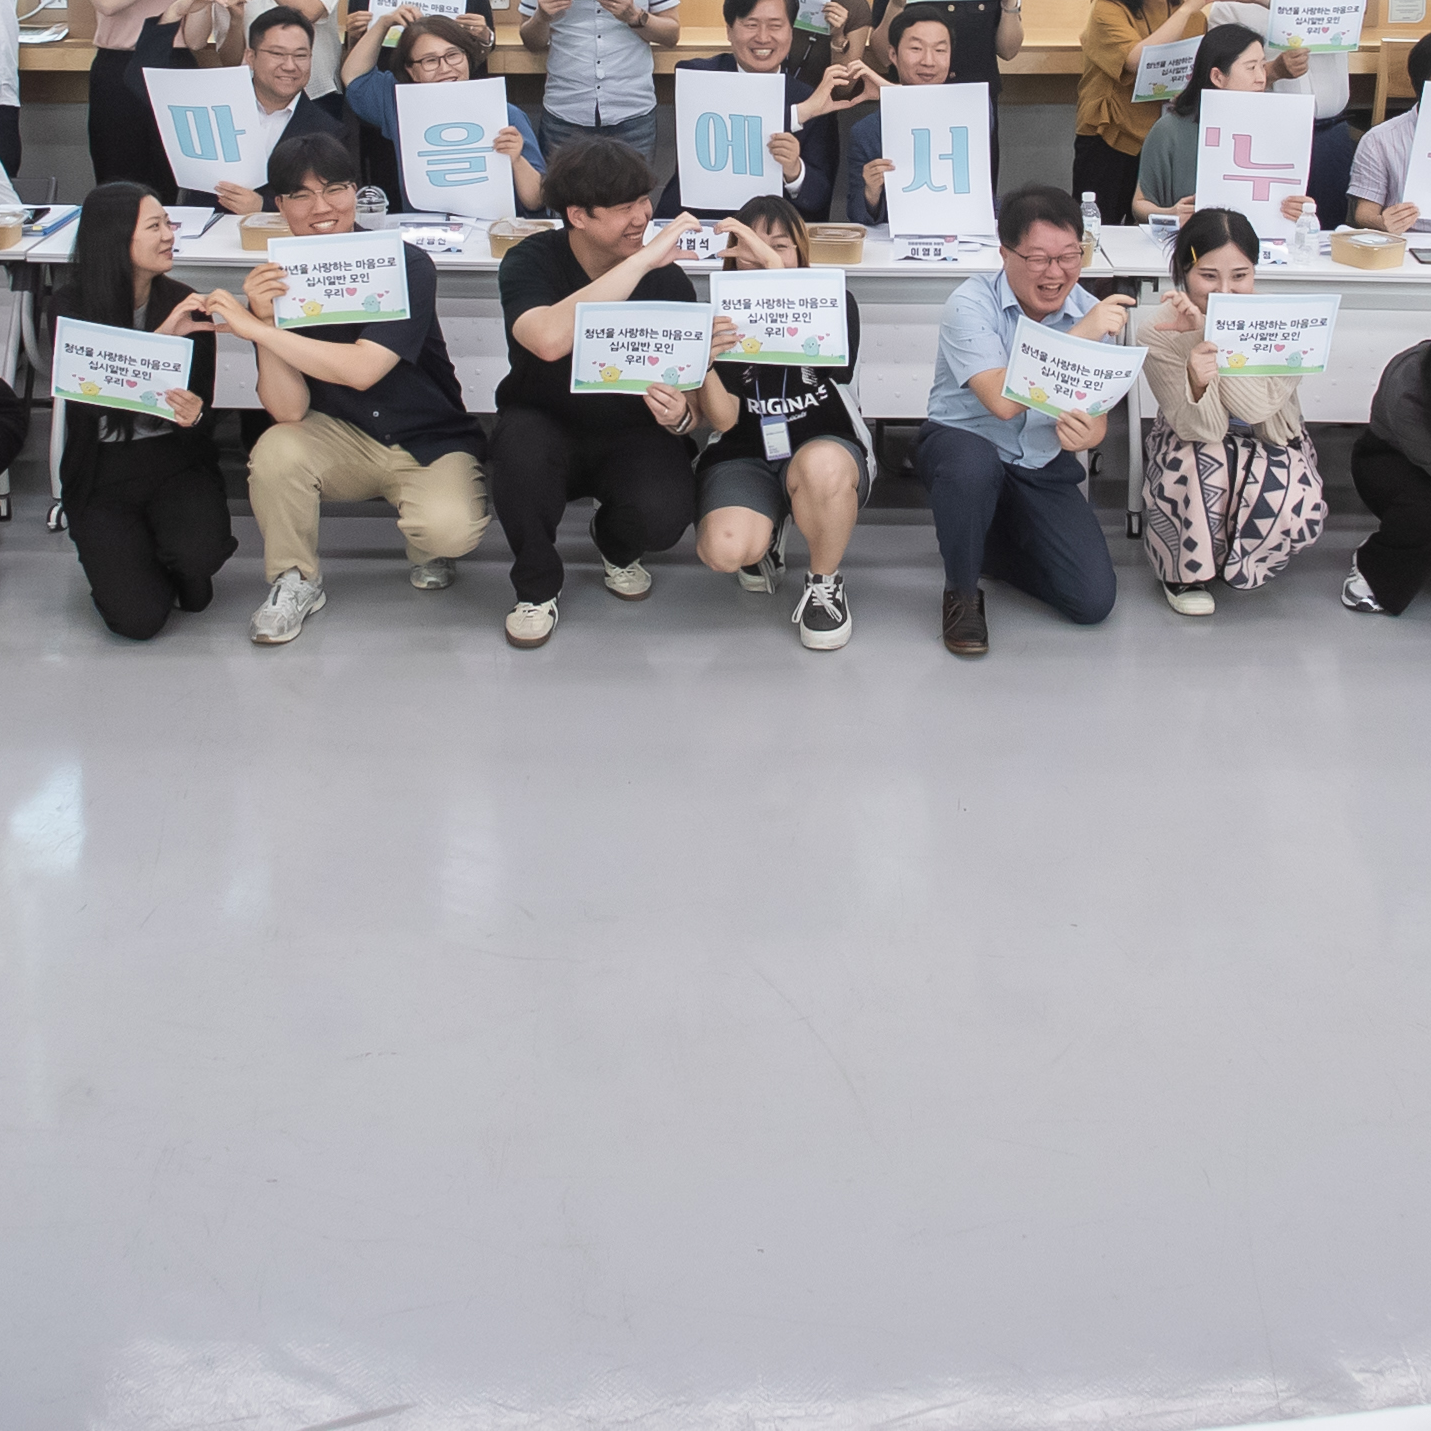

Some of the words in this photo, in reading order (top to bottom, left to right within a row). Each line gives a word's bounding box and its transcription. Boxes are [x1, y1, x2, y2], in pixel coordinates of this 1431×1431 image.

[1278, 7, 1299, 15] 청년을
[1302, 7, 1330, 15] 사랑하는
[1332, 6, 1359, 14] 마음으로
[168, 104, 246, 162] 마
[694, 112, 764, 178] 에
[417, 122, 494, 187] 을
[902, 126, 970, 194] 서
[312, 262, 352, 273] 사랑하는
[356, 257, 396, 269] 마음으로
[307, 275, 346, 287] 십시일반
[350, 273, 369, 283] 모인
[324, 288, 344, 298] 우리
[722, 299, 751, 310] 청년을
[756, 299, 795, 309] 사랑하는
[799, 298, 838, 310] 마음으로
[749, 313, 788, 324] 십시일반
[792, 312, 811, 323] 모인
[1217, 320, 1245, 330] 청년을
[1249, 321, 1286, 330] 사랑하는
[1291, 318, 1327, 328] 마음으로
[585, 328, 614, 339] 청년을
[618, 328, 659, 339] 사랑하는
[663, 330, 702, 340] 마음으로
[765, 327, 785, 337] 우리
[1240, 333, 1278, 341] 십시일반
[1281, 332, 1300, 341] 모인
[610, 342, 650, 352] 십시일반
[653, 343, 673, 354] 모인
[1253, 344, 1272, 353] 우리
[65, 343, 93, 357] 청년을
[97, 351, 138, 366] 사랑하는
[141, 359, 181, 372] 마음으로
[625, 355, 646, 365] 우리
[1022, 343, 1047, 362] 청년을
[1051, 357, 1091, 376] 사랑하는
[1094, 369, 1132, 378] 마음으로
[89, 361, 129, 376] 십시일반
[132, 369, 151, 381] 모인
[104, 376, 124, 387] 우리
[1042, 365, 1080, 387] 십시일반
[1082, 378, 1104, 391] 모인
[1054, 383, 1073, 398] 우리
